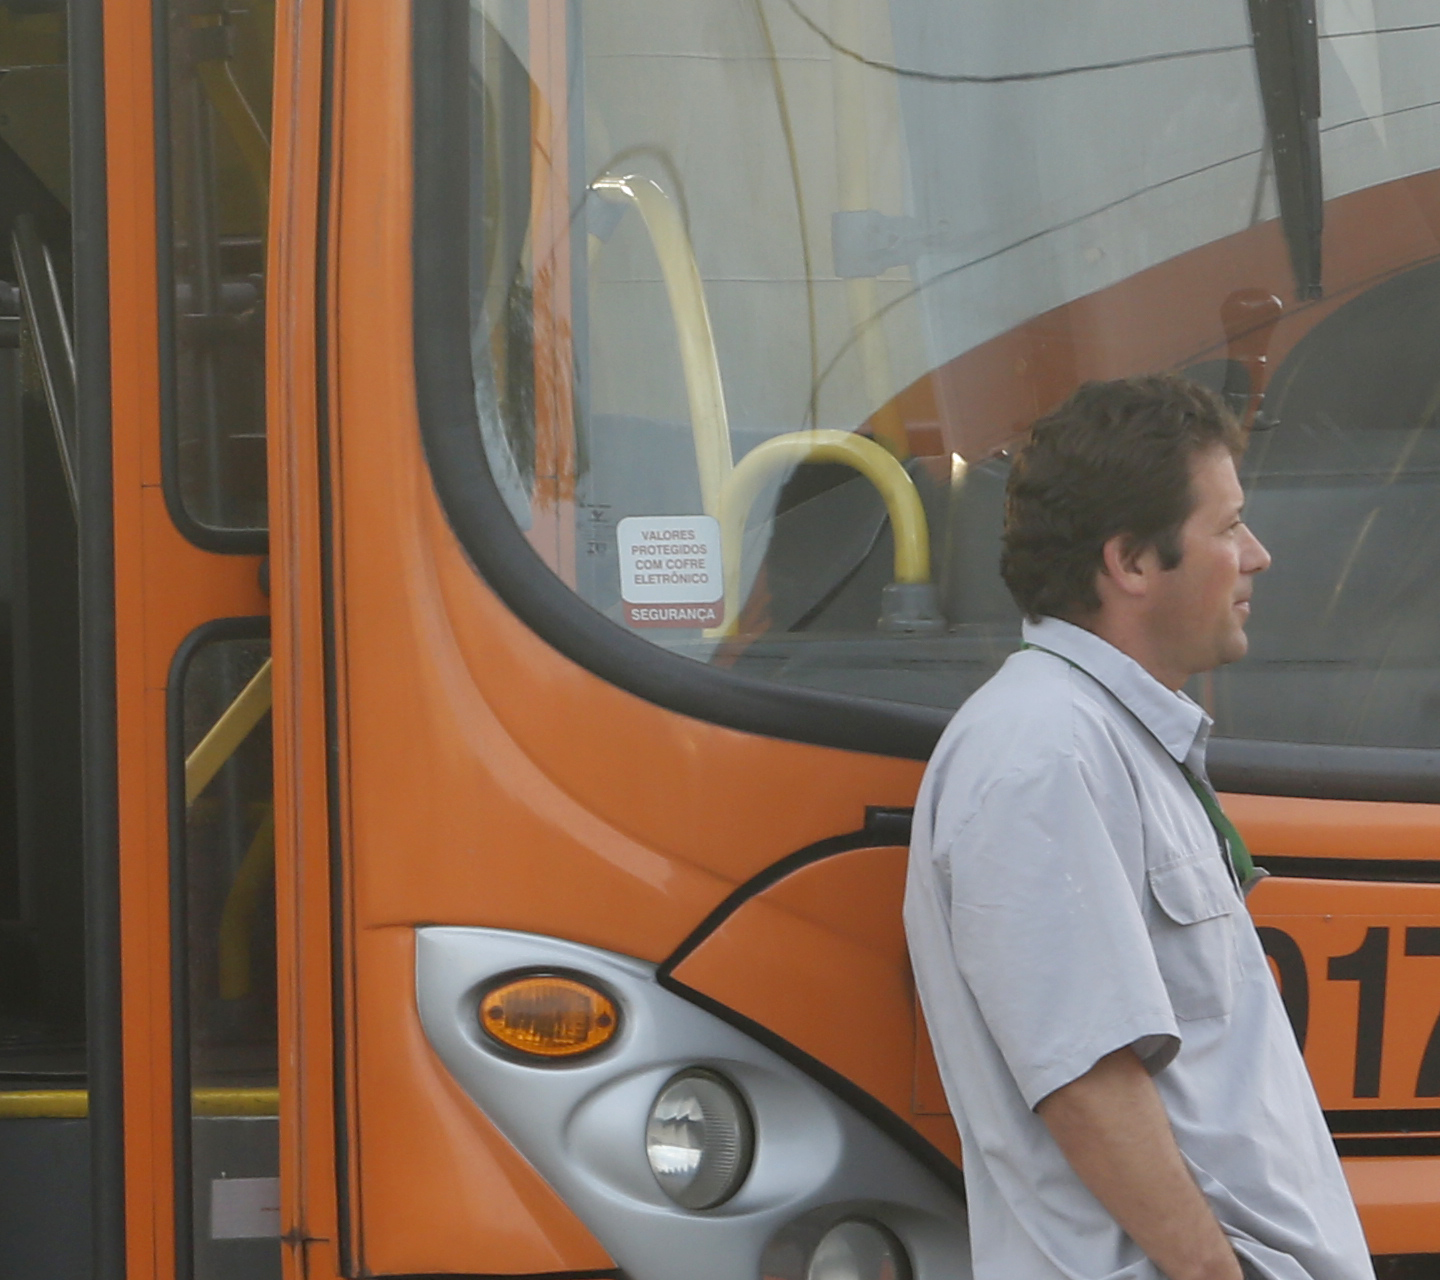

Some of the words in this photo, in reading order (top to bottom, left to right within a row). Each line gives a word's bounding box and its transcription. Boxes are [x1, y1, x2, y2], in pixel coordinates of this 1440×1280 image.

[641, 530, 695, 540] VALORES
[631, 544, 707, 555] PROTEGIDOS
[635, 559, 663, 570] COM
[665, 558, 706, 570] COFRE
[634, 572, 708, 585] ELETRÔNICO
[631, 608, 716, 623] SEGURANÇA
